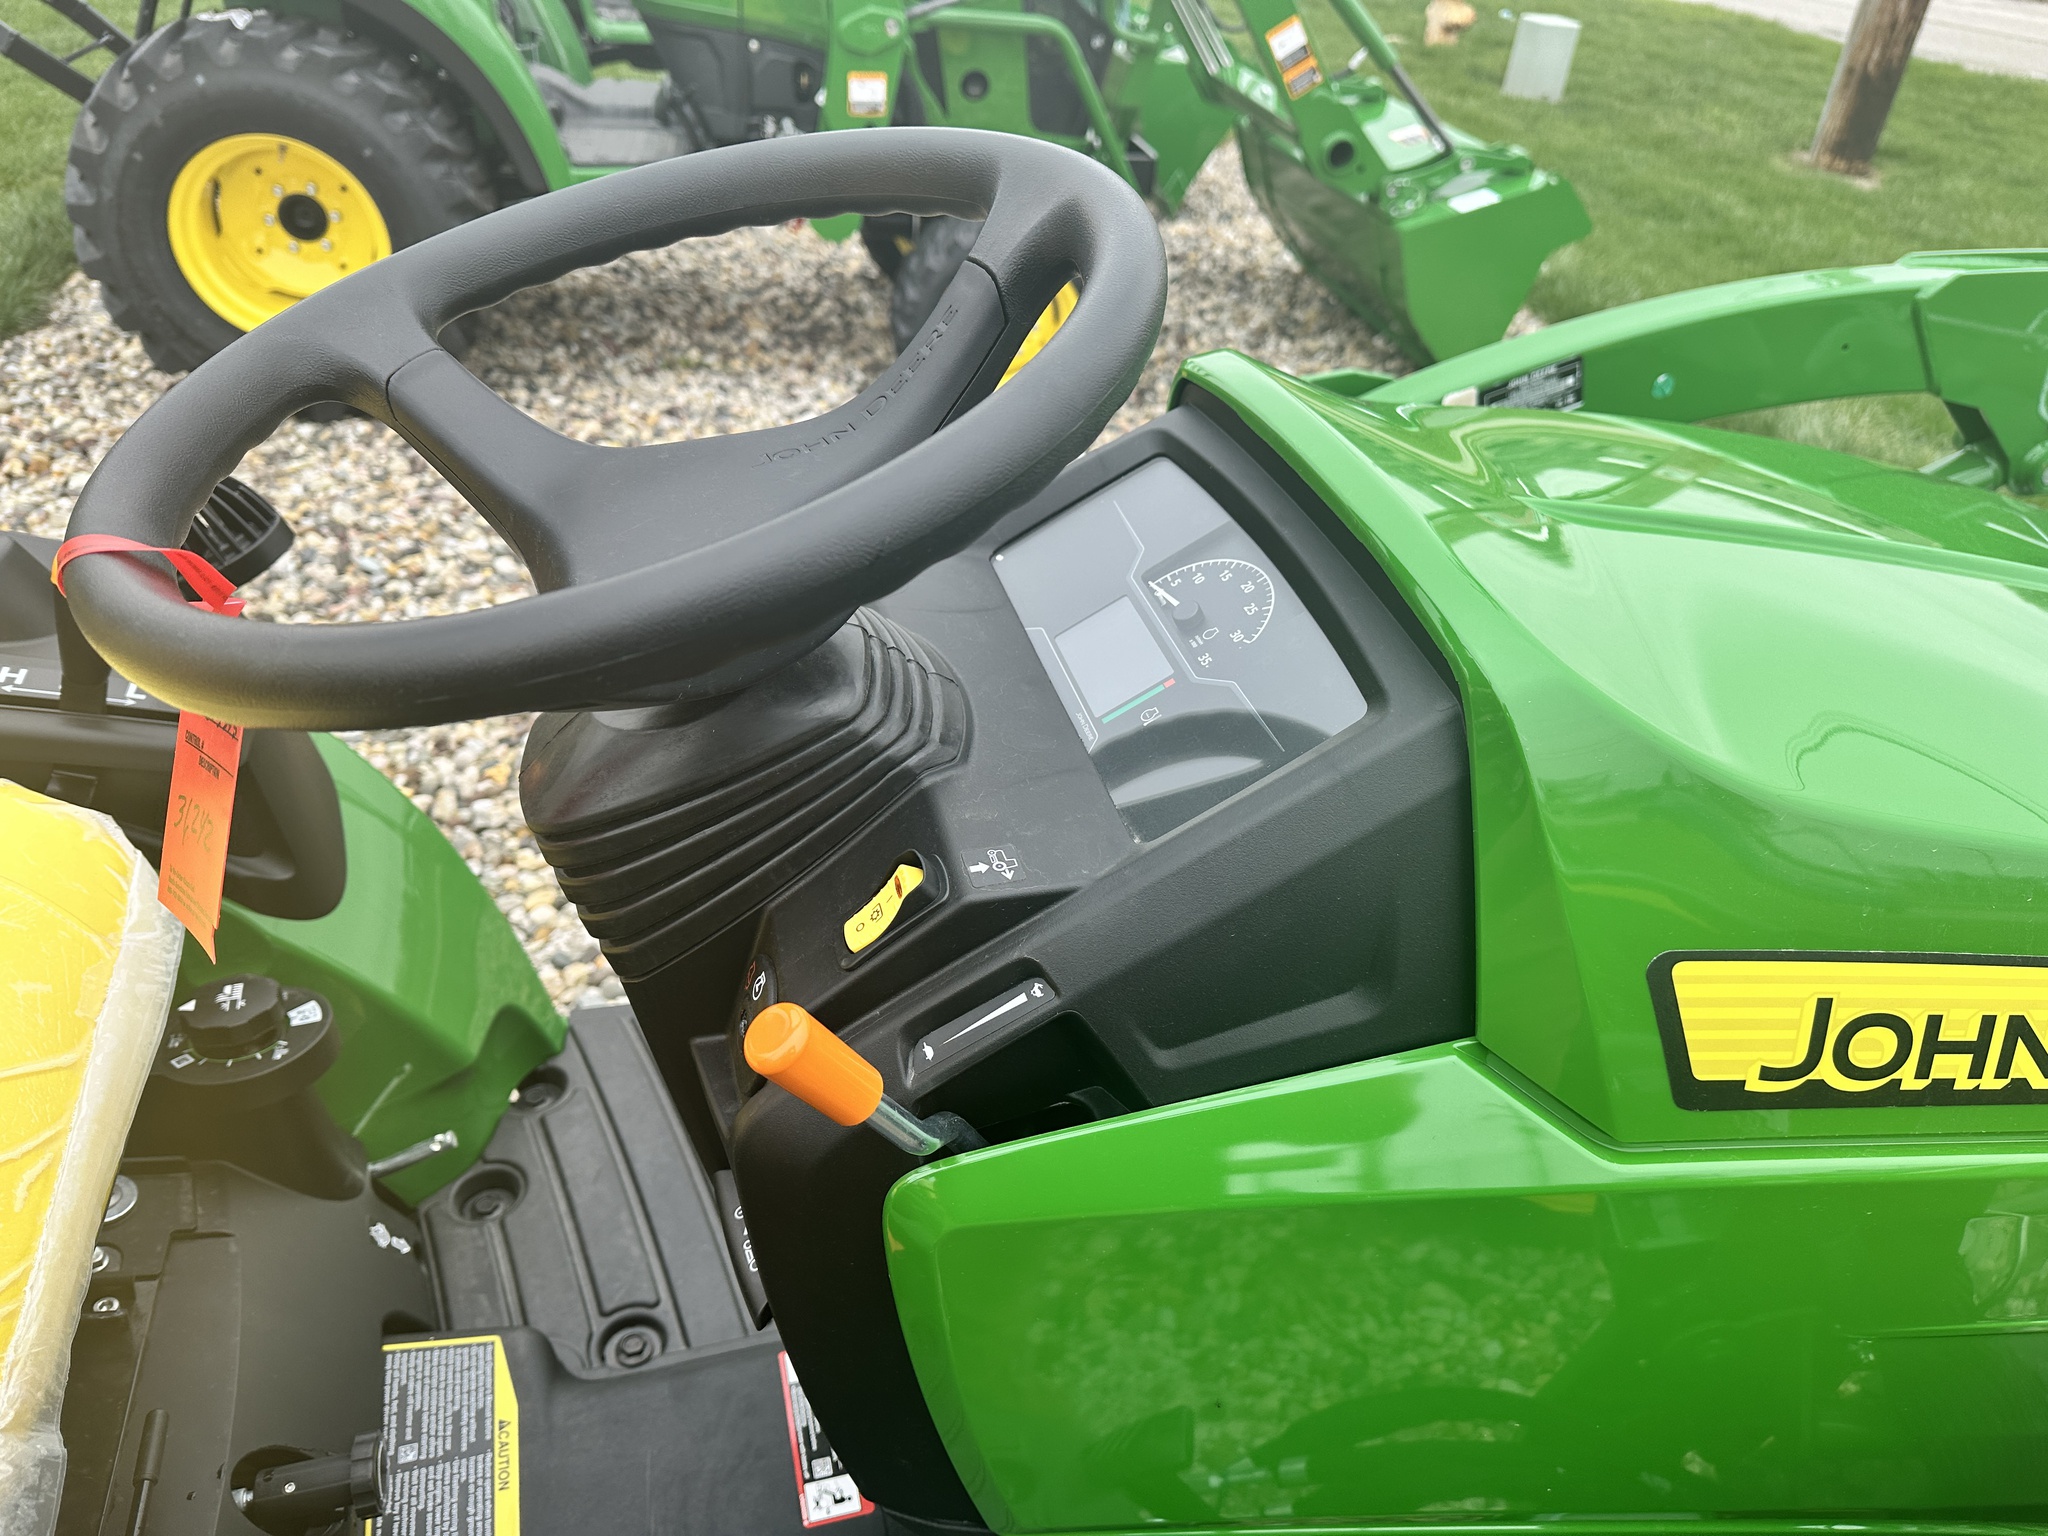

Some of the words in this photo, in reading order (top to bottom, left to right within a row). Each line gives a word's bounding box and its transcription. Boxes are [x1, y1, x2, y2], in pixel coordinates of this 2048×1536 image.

[752, 423, 856, 469] JOHN
[862, 304, 960, 420] DEERE
[1192, 572, 1205, 584] 10
[1220, 570, 1232, 582] 15
[1170, 579, 1182, 587] 5
[1240, 581, 1255, 594] 20
[1243, 603, 1258, 616] 25
[1229, 630, 1244, 642] 30
[0, 666, 28, 684] H
[125, 682, 147, 700] L
[1758, 998, 2048, 1082] JOHN
[498, 1430, 510, 1491] CAUTION
